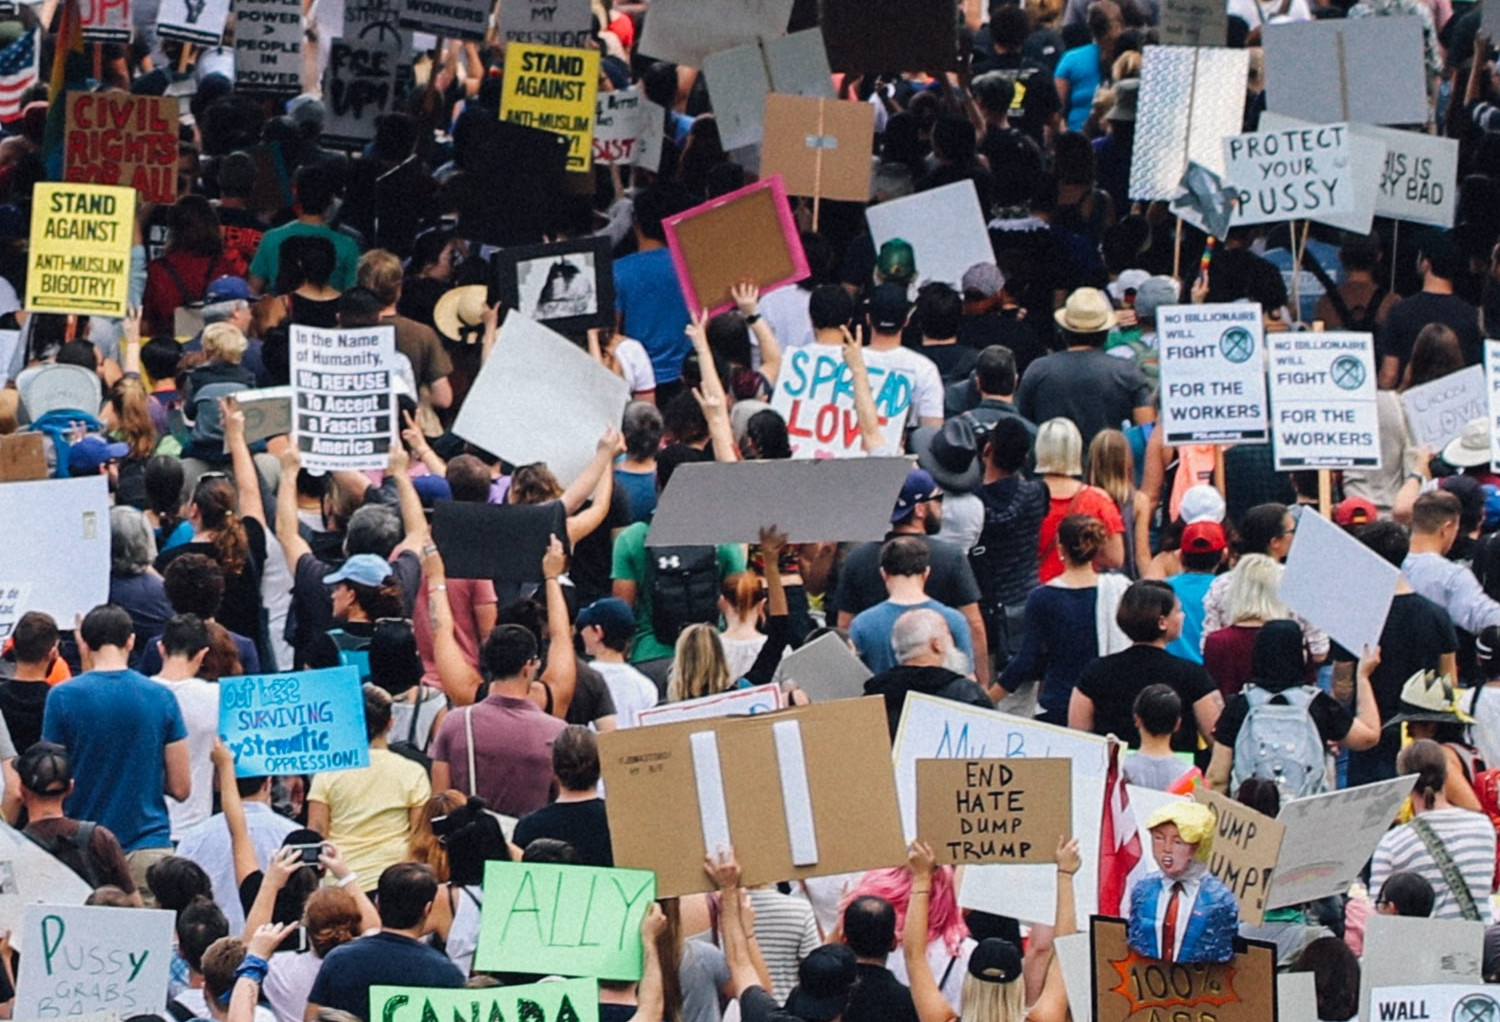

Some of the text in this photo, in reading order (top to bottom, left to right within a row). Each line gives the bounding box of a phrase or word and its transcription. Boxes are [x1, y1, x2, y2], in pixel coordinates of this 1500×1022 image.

[237, 10, 299, 24] POWER
[237, 38, 299, 52] PEOPLE
[260, 54, 277, 65] IN
[237, 71, 299, 84] POWER
[73, 95, 169, 132] CIVIL
[68, 130, 177, 166] RIGHTS
[1231, 126, 1345, 159] PROTECT
[1260, 158, 1314, 180] YOUR
[51, 192, 116, 216] STAND
[1237, 179, 1339, 216] PUSSY
[44, 218, 119, 243] AGAINST
[35, 253, 124, 274] ANTI-MUSLIM
[41, 274, 115, 295] BIGOTRY!
[1167, 344, 1216, 360] FIGHT
[320, 373, 386, 390] REFUSE
[1169, 381, 1243, 398] FOR THE
[305, 393, 379, 412] To Accept
[1170, 405, 1260, 420] WORKERS
[308, 416, 377, 433] a Fascist
[311, 439, 374, 454] America
[239, 701, 332, 730] SURVIVING
[265, 749, 359, 772] OPPRESSION!
[966, 762, 1013, 787] END
[957, 790, 1024, 813] HATE
[960, 818, 1022, 836] DUMP
[947, 841, 1031, 859] TRUMP
[511, 870, 653, 950] ALLY
[1132, 965, 1221, 1000] 100%
[57, 984, 136, 1007] GRABS
